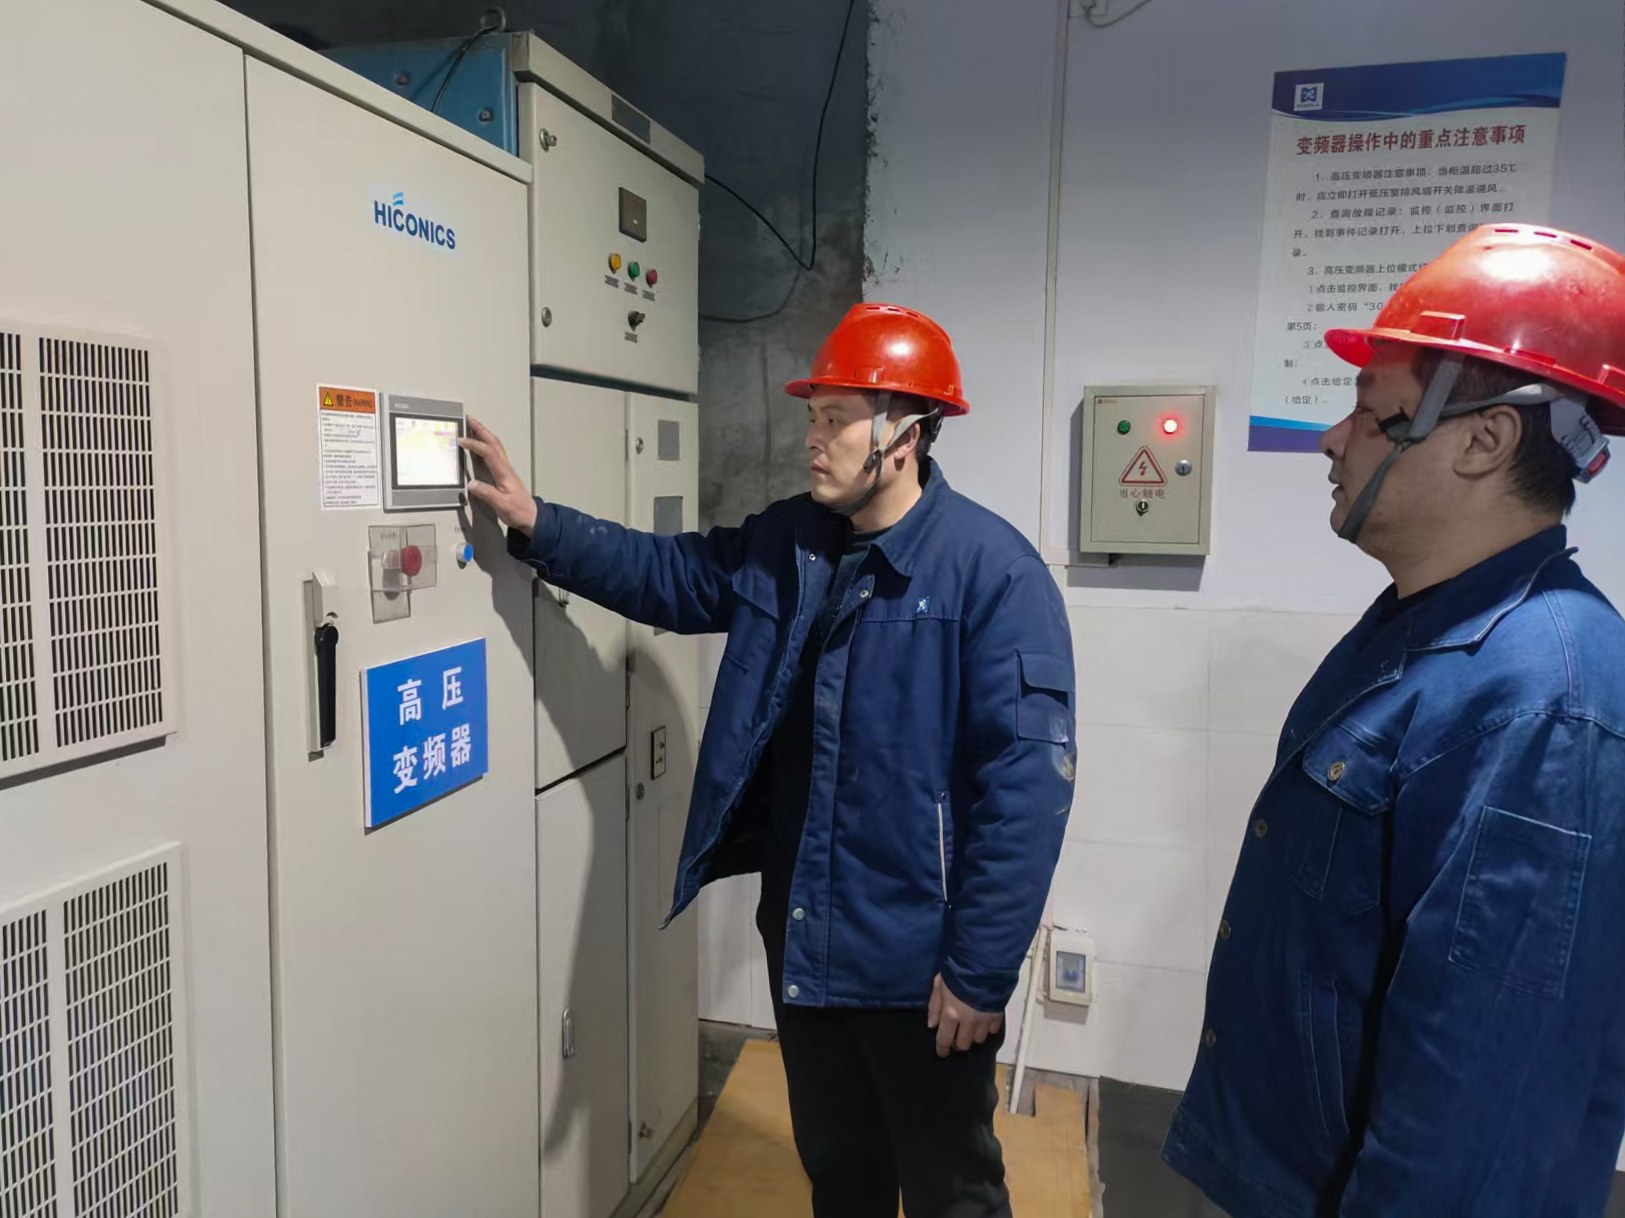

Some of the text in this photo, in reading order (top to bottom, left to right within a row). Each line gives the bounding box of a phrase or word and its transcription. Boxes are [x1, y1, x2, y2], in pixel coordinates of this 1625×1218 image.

[1296, 124, 1527, 156] 变频器操作中的重点注意事项
[374, 199, 456, 250] HICONICS
[397, 666, 464, 726] 高压
[393, 723, 472, 794] 变频器
